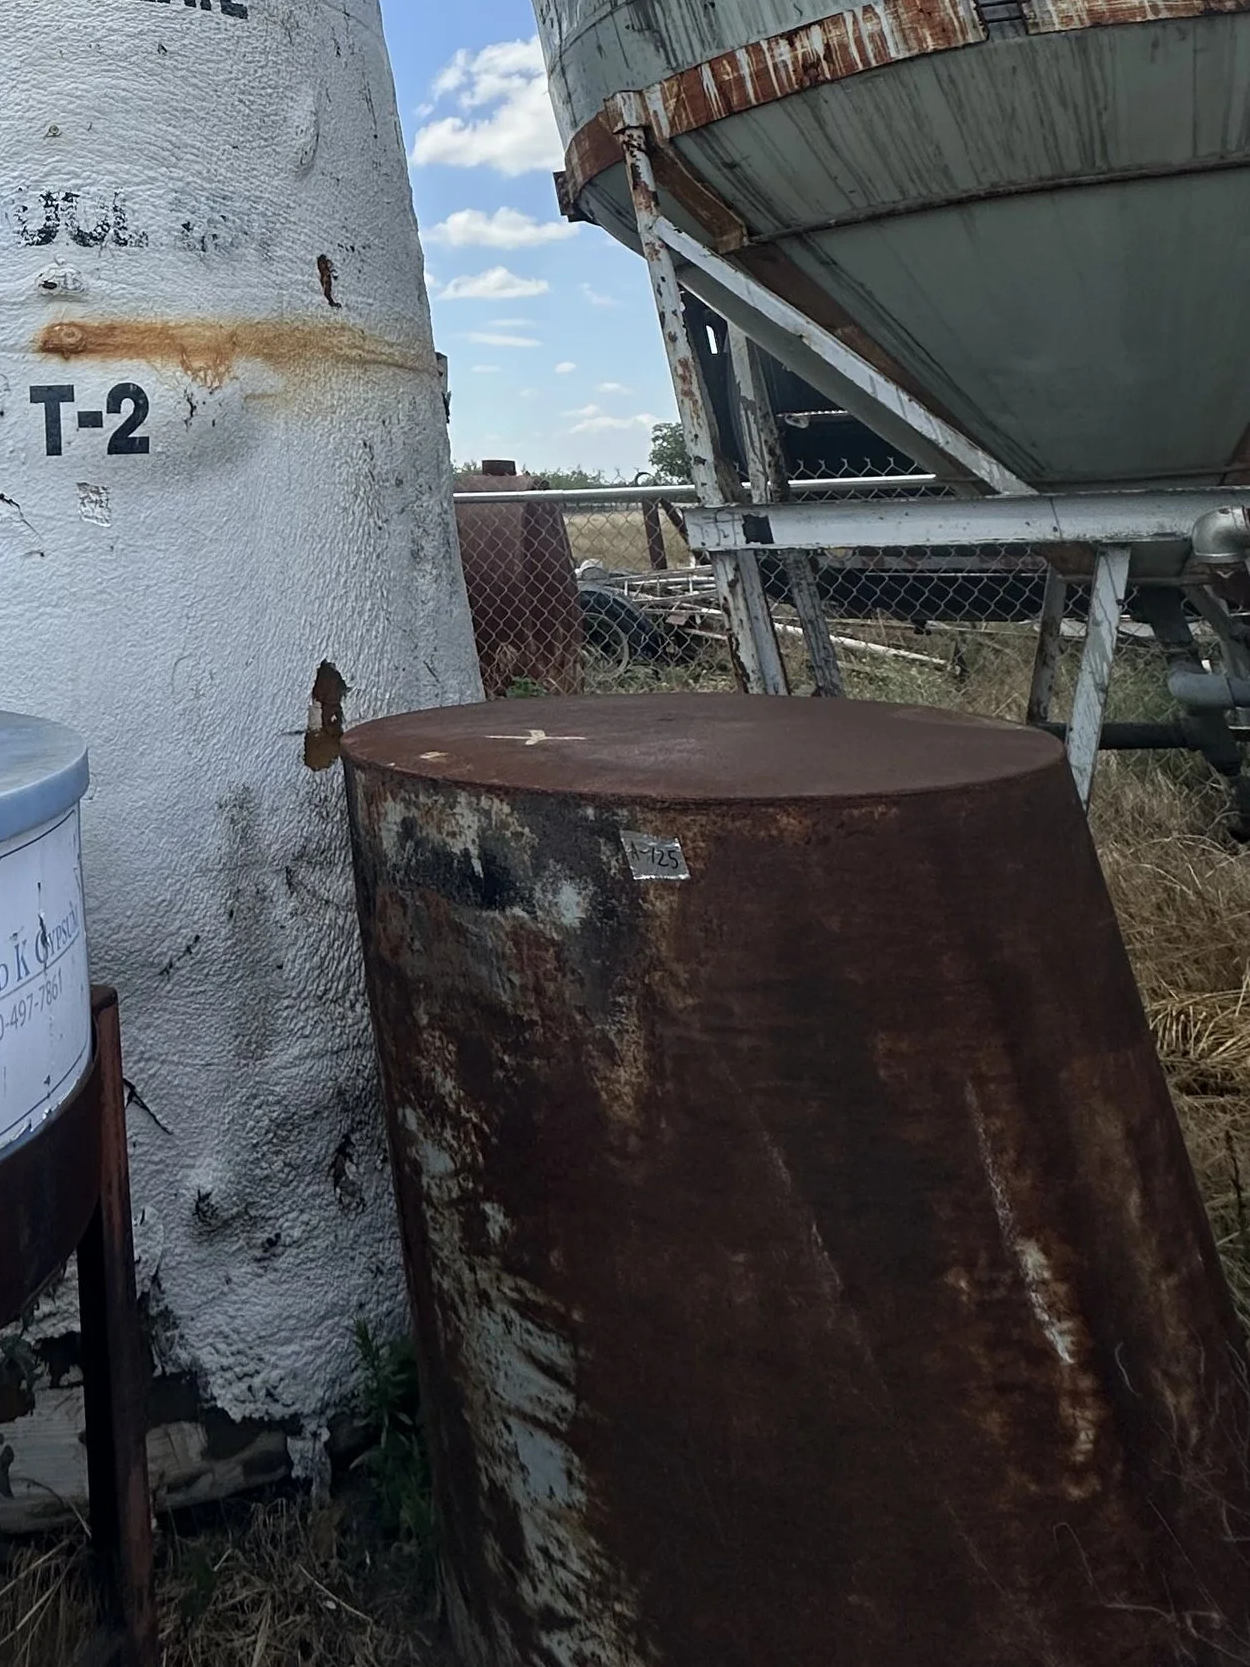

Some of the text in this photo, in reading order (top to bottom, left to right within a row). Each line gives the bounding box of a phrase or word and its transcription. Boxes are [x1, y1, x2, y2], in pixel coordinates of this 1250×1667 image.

[29, 382, 150, 456] T-2
[629, 841, 679, 869] A-125
[14, 939, 31, 982] K
